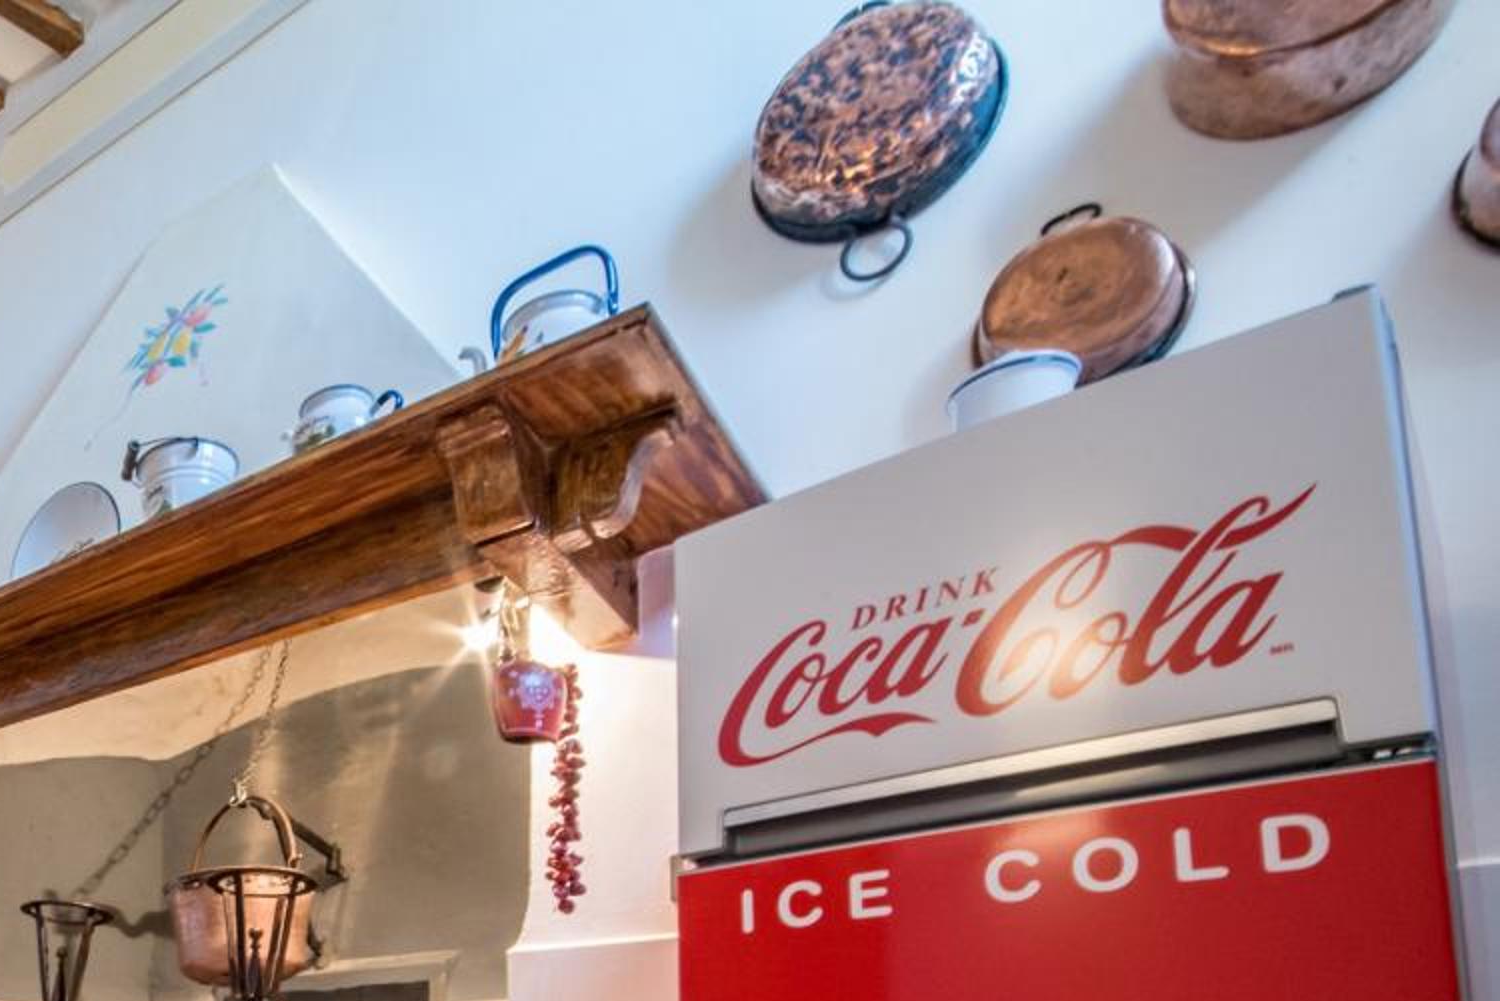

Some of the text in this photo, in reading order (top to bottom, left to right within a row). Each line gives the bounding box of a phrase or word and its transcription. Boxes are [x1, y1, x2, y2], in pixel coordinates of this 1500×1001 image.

[717, 482, 1316, 768] Coca-Cola
[851, 567, 998, 630] DRINK
[741, 813, 1330, 934] ICE COLD
